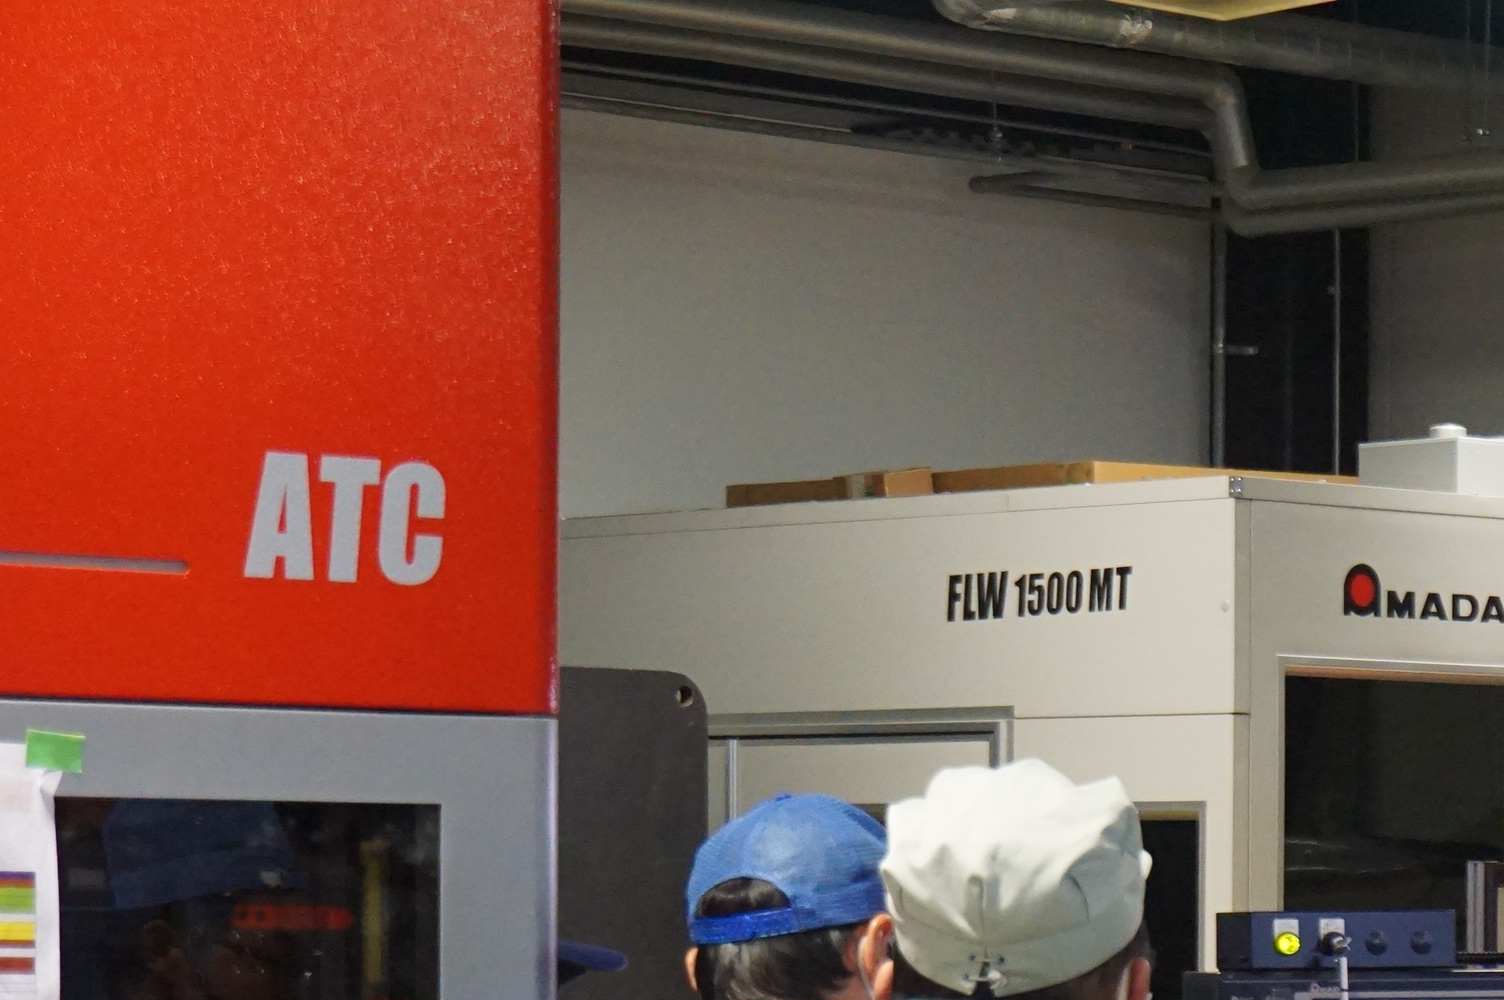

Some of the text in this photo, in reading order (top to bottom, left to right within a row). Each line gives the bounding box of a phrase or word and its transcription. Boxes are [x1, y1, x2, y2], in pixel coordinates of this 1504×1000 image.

[243, 451, 447, 586] ATC
[947, 566, 1134, 622] FLW 1500 MT
